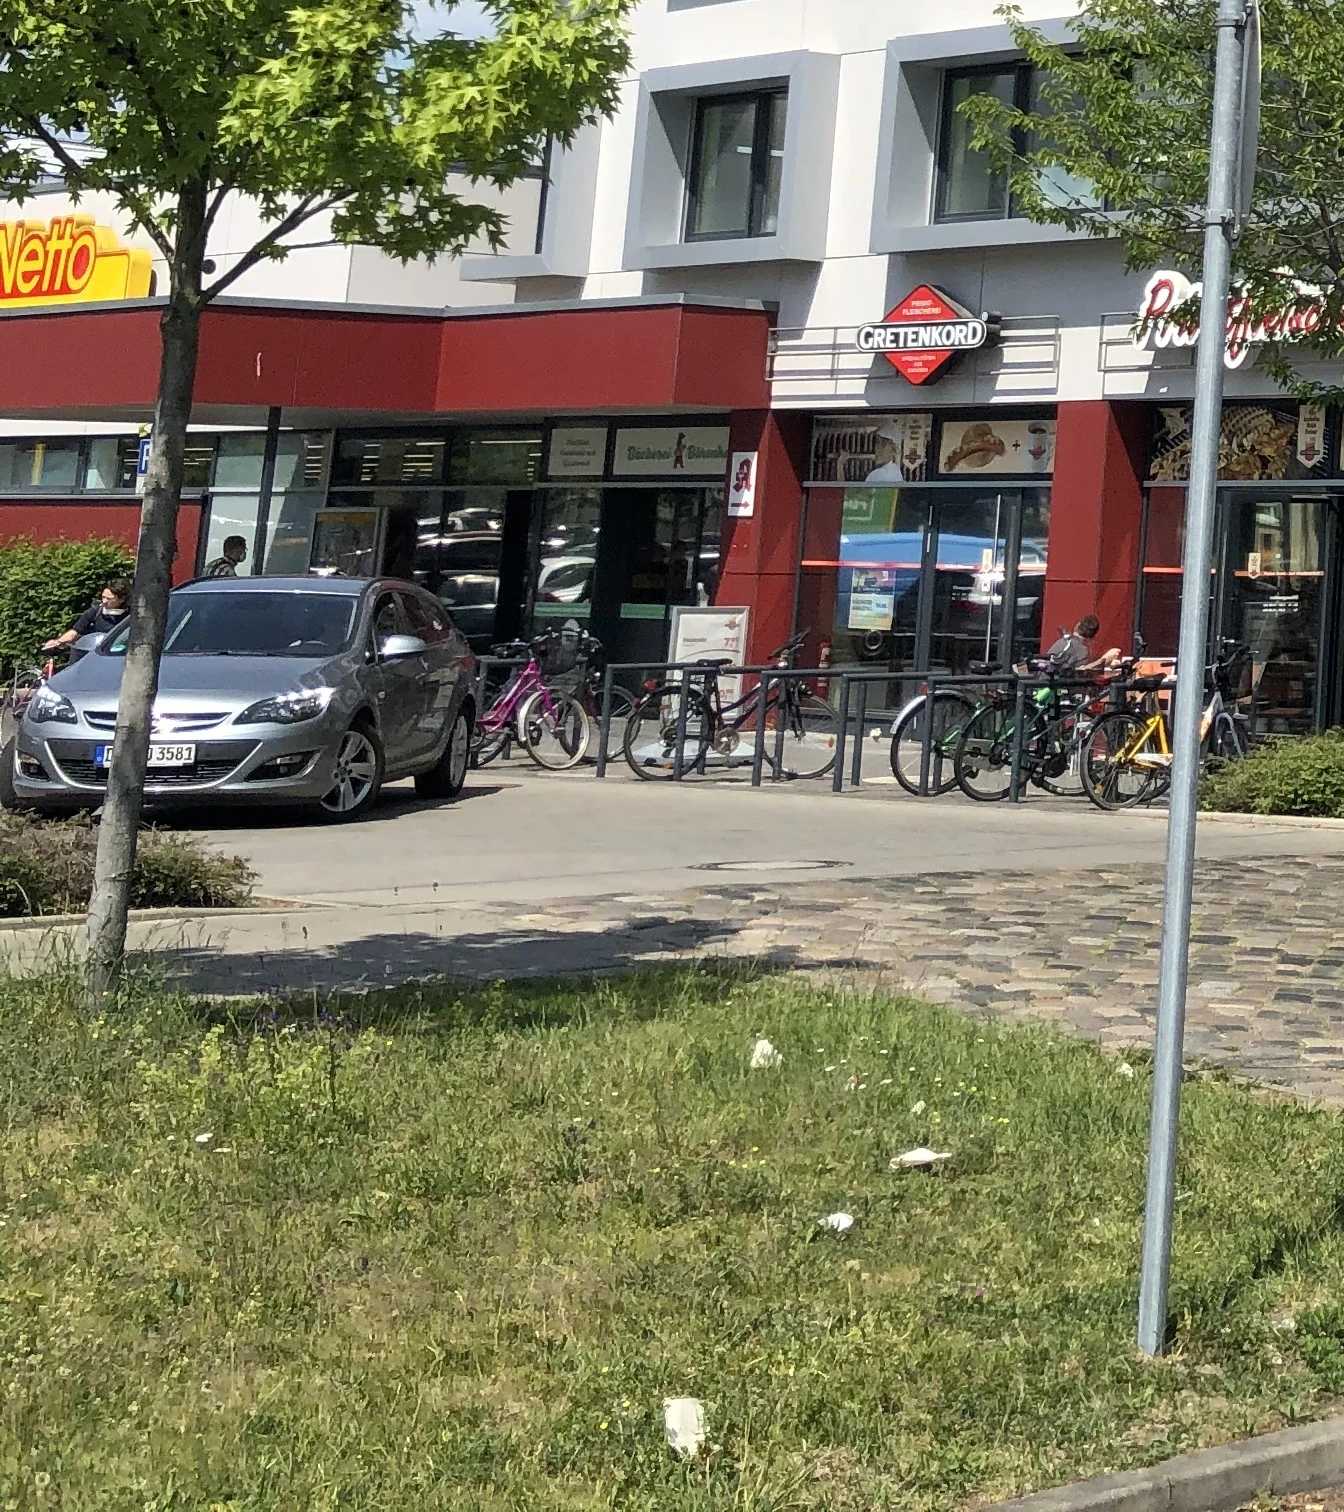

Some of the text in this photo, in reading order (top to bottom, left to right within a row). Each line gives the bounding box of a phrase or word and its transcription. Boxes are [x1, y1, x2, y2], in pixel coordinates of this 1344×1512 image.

[0, 220, 95, 294] Netto
[859, 321, 983, 350] GRETENKORD
[156, 746, 193, 761] 3581
